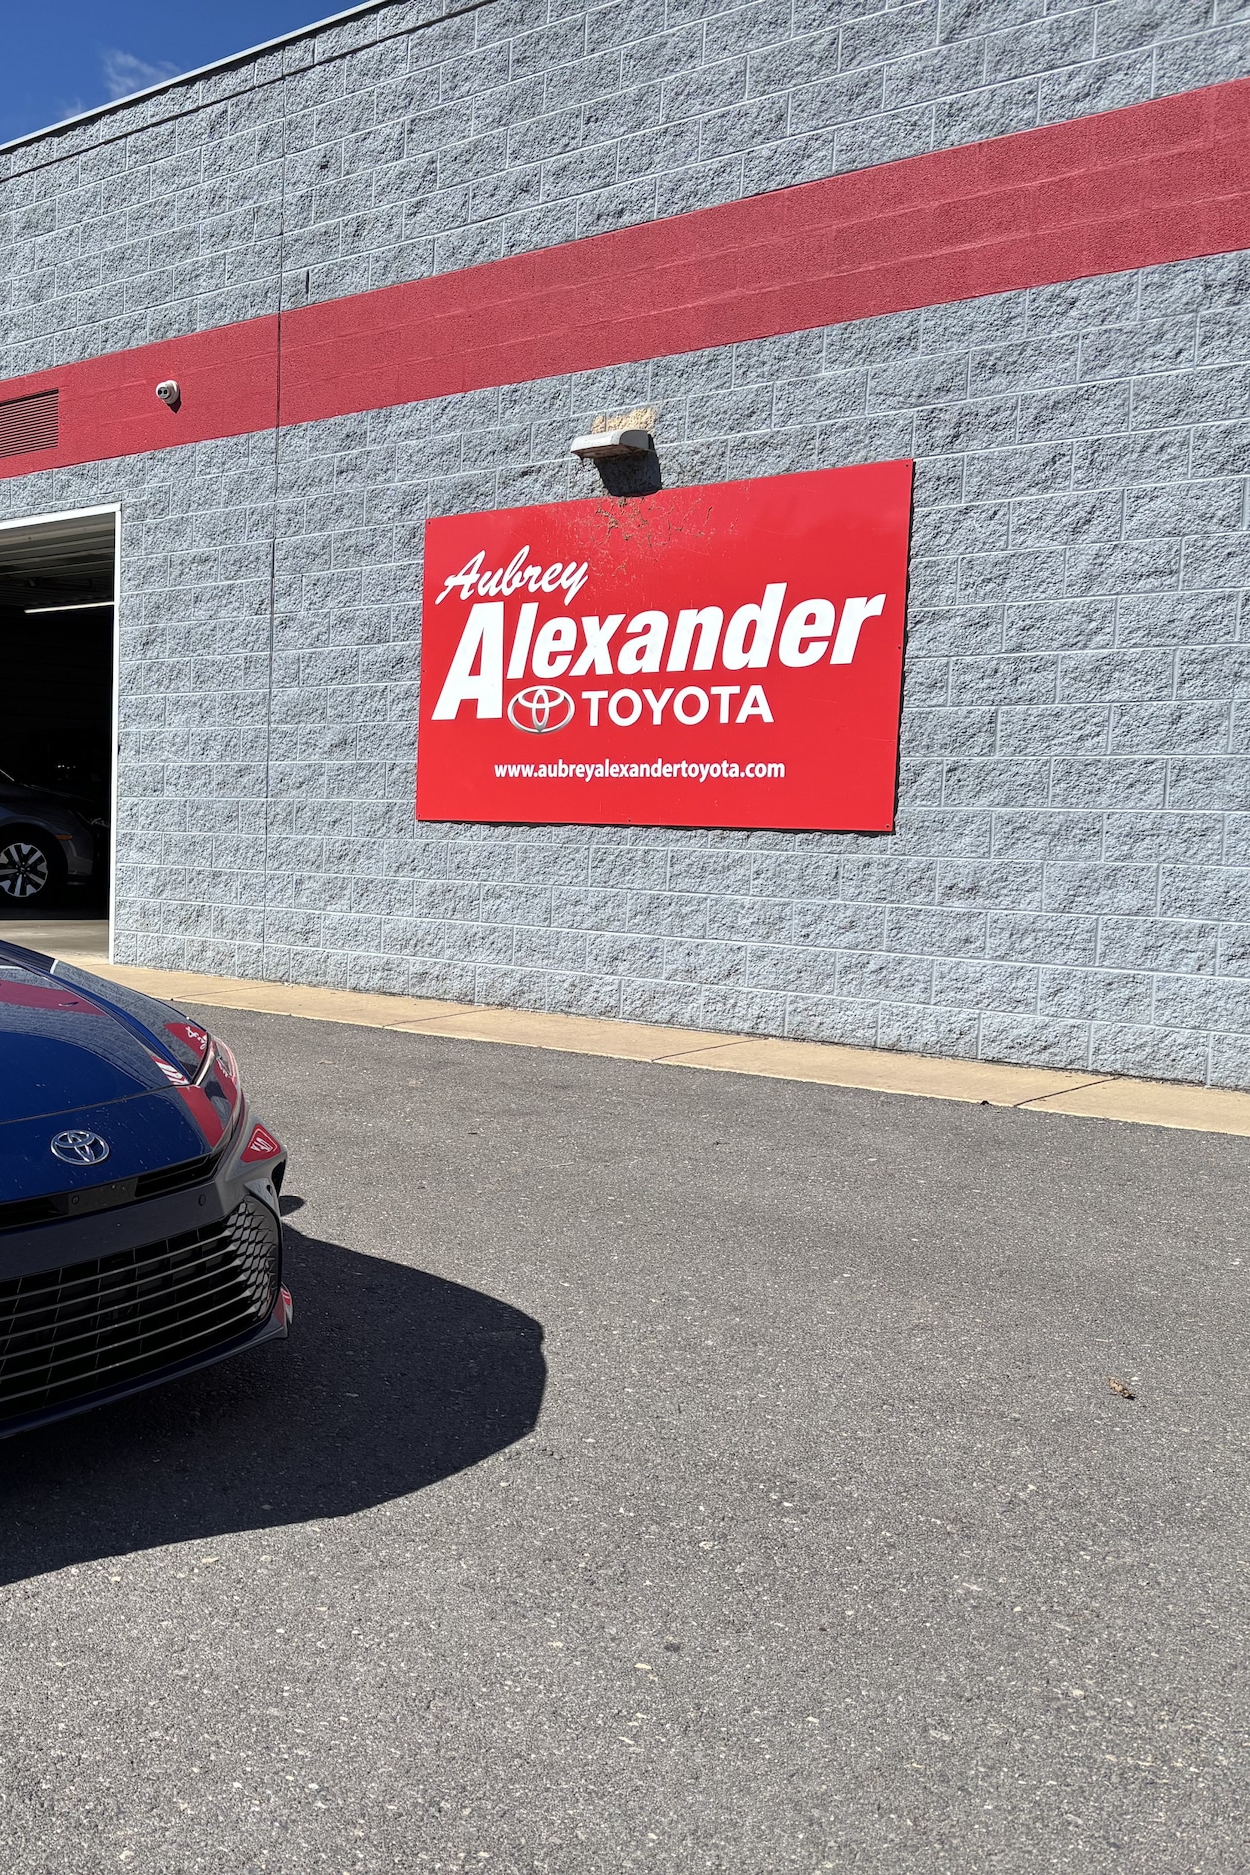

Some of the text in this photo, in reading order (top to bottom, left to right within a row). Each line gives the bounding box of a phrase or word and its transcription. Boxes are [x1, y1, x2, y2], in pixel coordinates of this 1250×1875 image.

[435, 545, 588, 606] Aubrey
[432, 583, 886, 720] Alexander
[582, 685, 774, 727] TOYOTA
[495, 758, 785, 783] www.aubreyalexandertoyota.com
